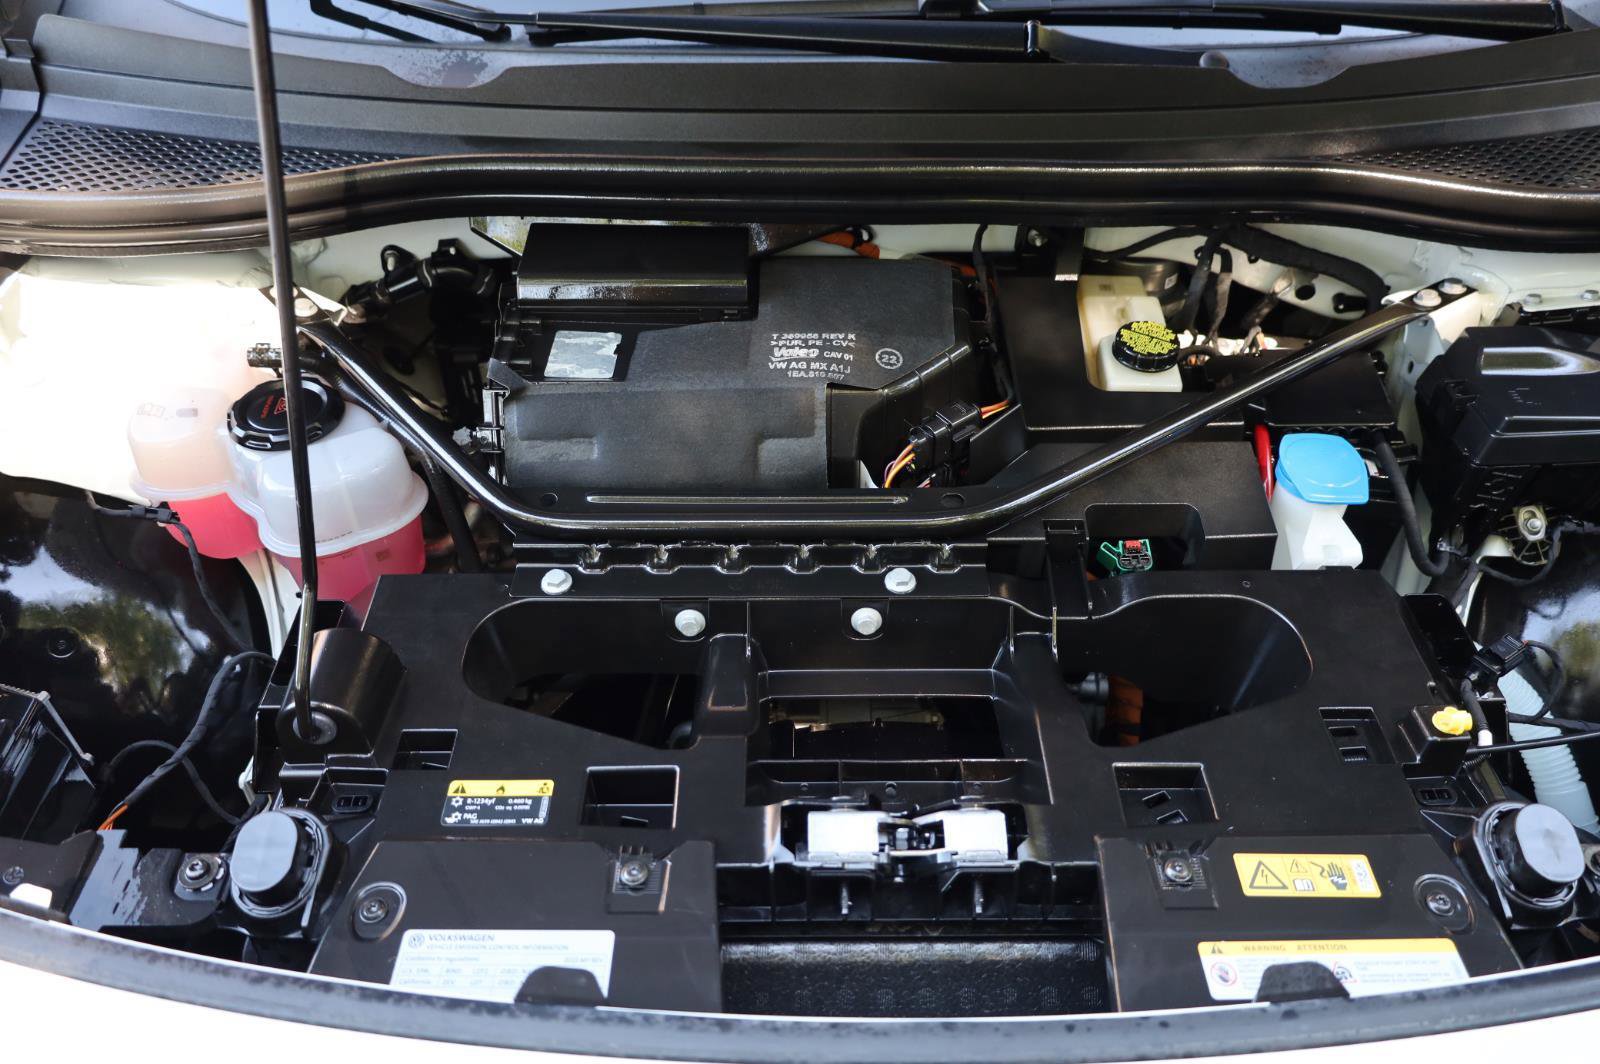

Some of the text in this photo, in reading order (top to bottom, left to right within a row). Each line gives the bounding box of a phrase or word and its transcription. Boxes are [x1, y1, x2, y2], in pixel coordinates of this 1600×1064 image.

[847, 333, 856, 341] K
[823, 351, 842, 359] CAV
[881, 354, 898, 364] 22
[768, 362, 787, 370] VW
[788, 362, 807, 370] AG
[810, 362, 828, 371] MX
[466, 797, 497, 806] R-1234yf
[463, 812, 478, 820] PAG
[1242, 942, 1348, 952] WARNING ATTENTION
